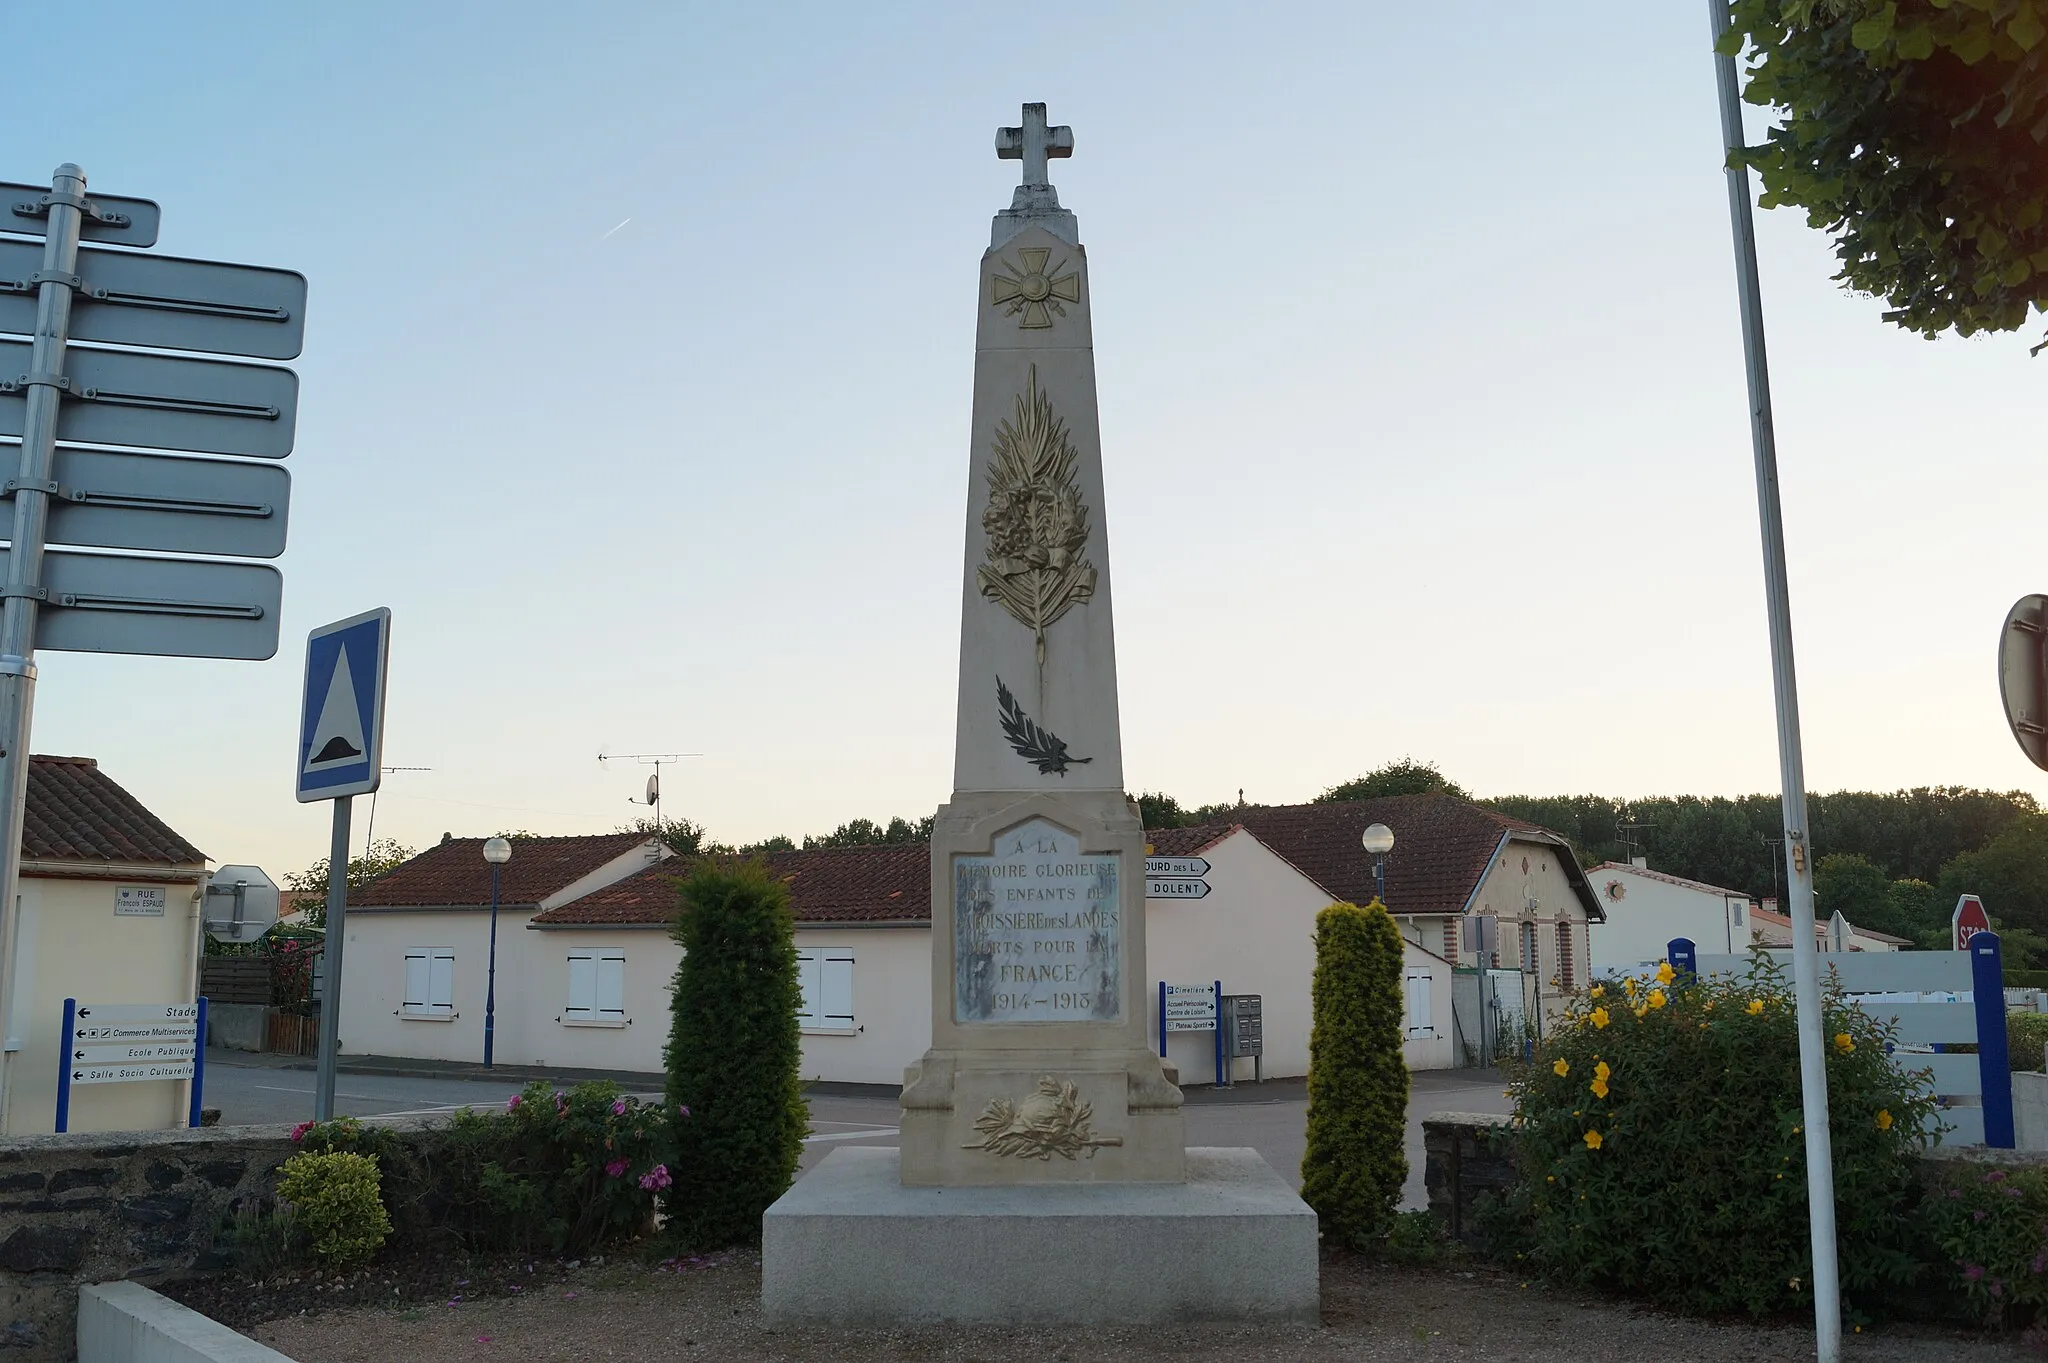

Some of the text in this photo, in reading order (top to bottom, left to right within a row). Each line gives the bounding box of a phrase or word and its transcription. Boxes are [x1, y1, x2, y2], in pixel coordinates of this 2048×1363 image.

[1037, 840, 1058, 854] LA
[1035, 863, 1117, 878] GLORIEUSE
[1190, 862, 1199, 872] L.
[137, 890, 155, 898] RUE
[1006, 888, 1076, 901] ENFANTS
[1154, 883, 1199, 894] DOLENT
[1033, 940, 1076, 954] POUR
[1000, 964, 1078, 982] FRANCE
[166, 1007, 196, 1017] Stade
[113, 1027, 196, 1037] Commerce Multiservices
[128, 1046, 195, 1058] Ecole Publique
[90, 1065, 194, 1079] Salle Socio Culturelle
